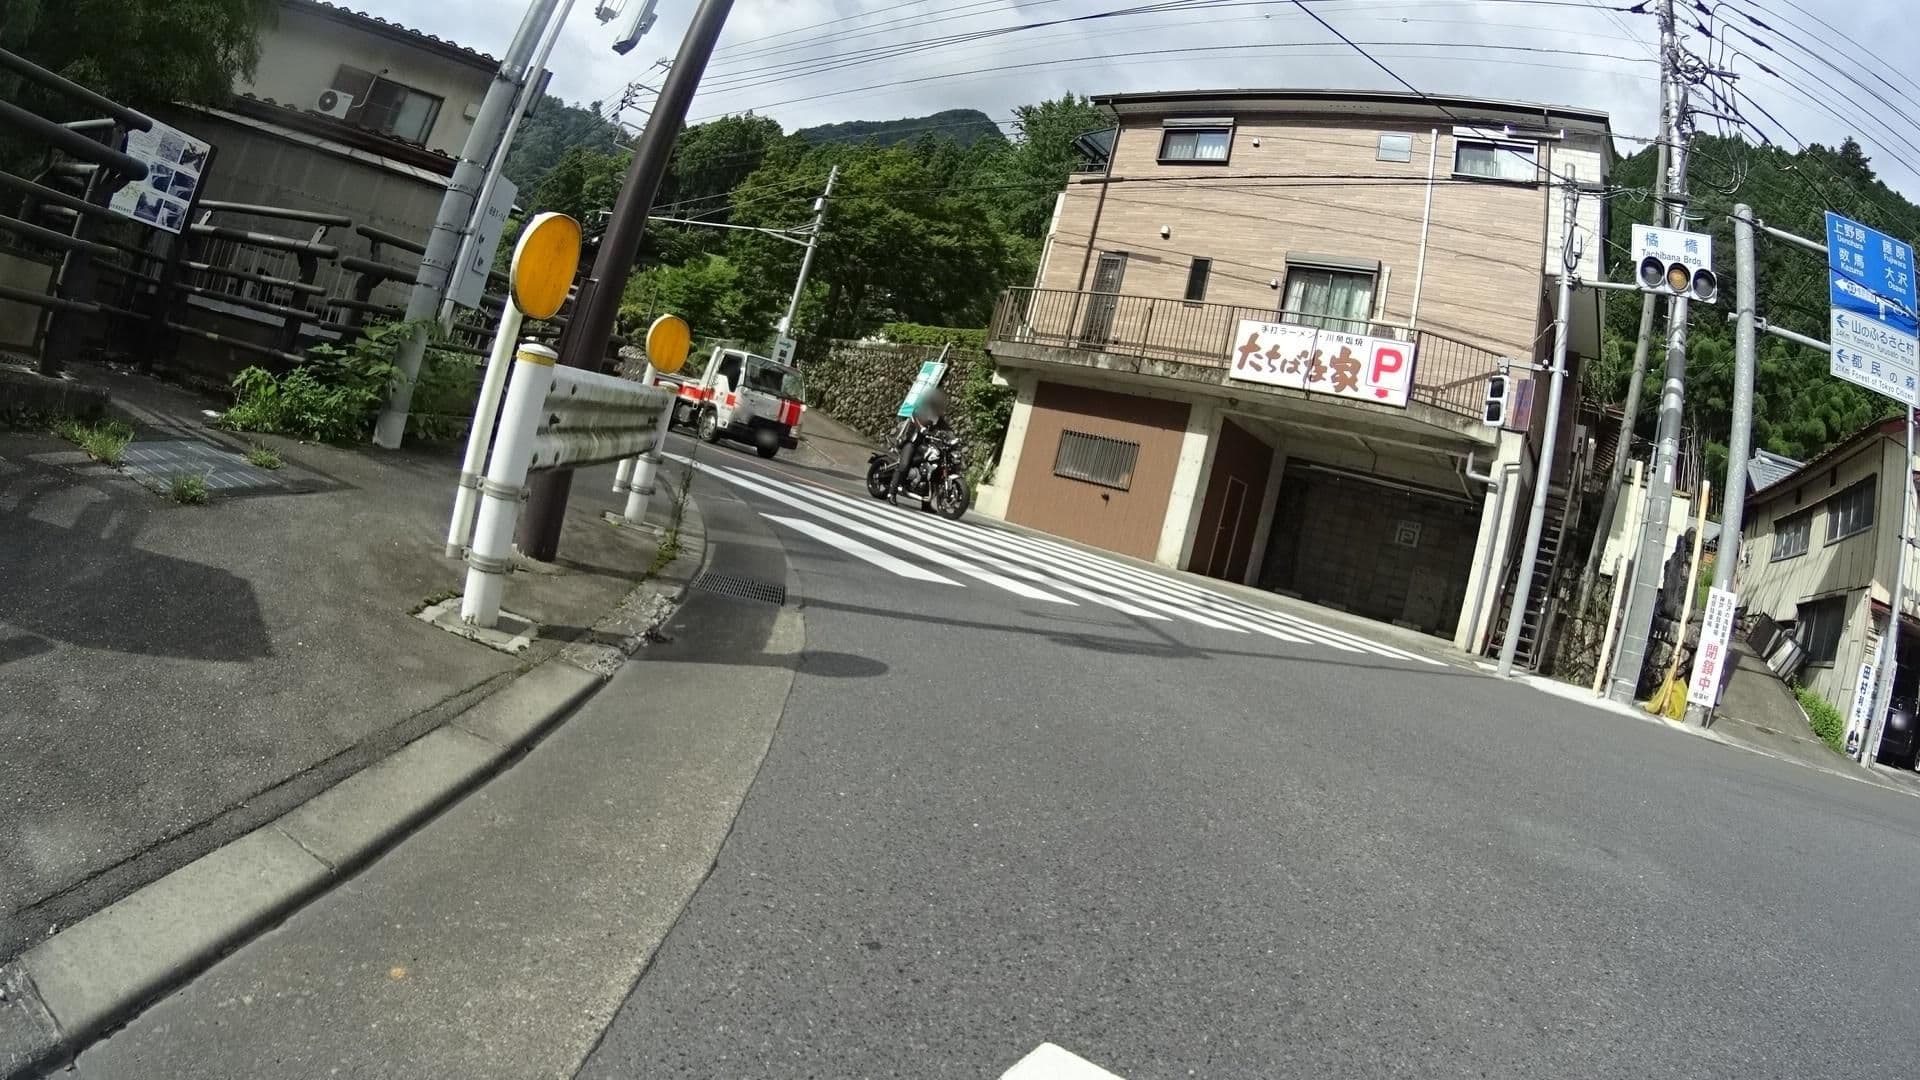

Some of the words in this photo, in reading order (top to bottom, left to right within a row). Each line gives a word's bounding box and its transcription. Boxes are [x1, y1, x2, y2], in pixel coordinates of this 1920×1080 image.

[1645, 231, 1698, 254] 橘橋
[1833, 220, 1866, 243] 上野原
[1642, 249, 1680, 262] Tachibana
[1838, 247, 1865, 269] 数馬
[1882, 239, 1906, 261] 藤原
[1883, 253, 1907, 269] Fujiwara
[1840, 261, 1864, 277] Kazuma
[1884, 266, 1909, 287] 大沢
[1851, 319, 1914, 357] 山のふるさと村
[1237, 331, 1362, 393] たちばな家
[1372, 347, 1403, 384] P
[1851, 353, 1916, 390] 都民の森
[1879, 380, 1894, 393] Tokyo
